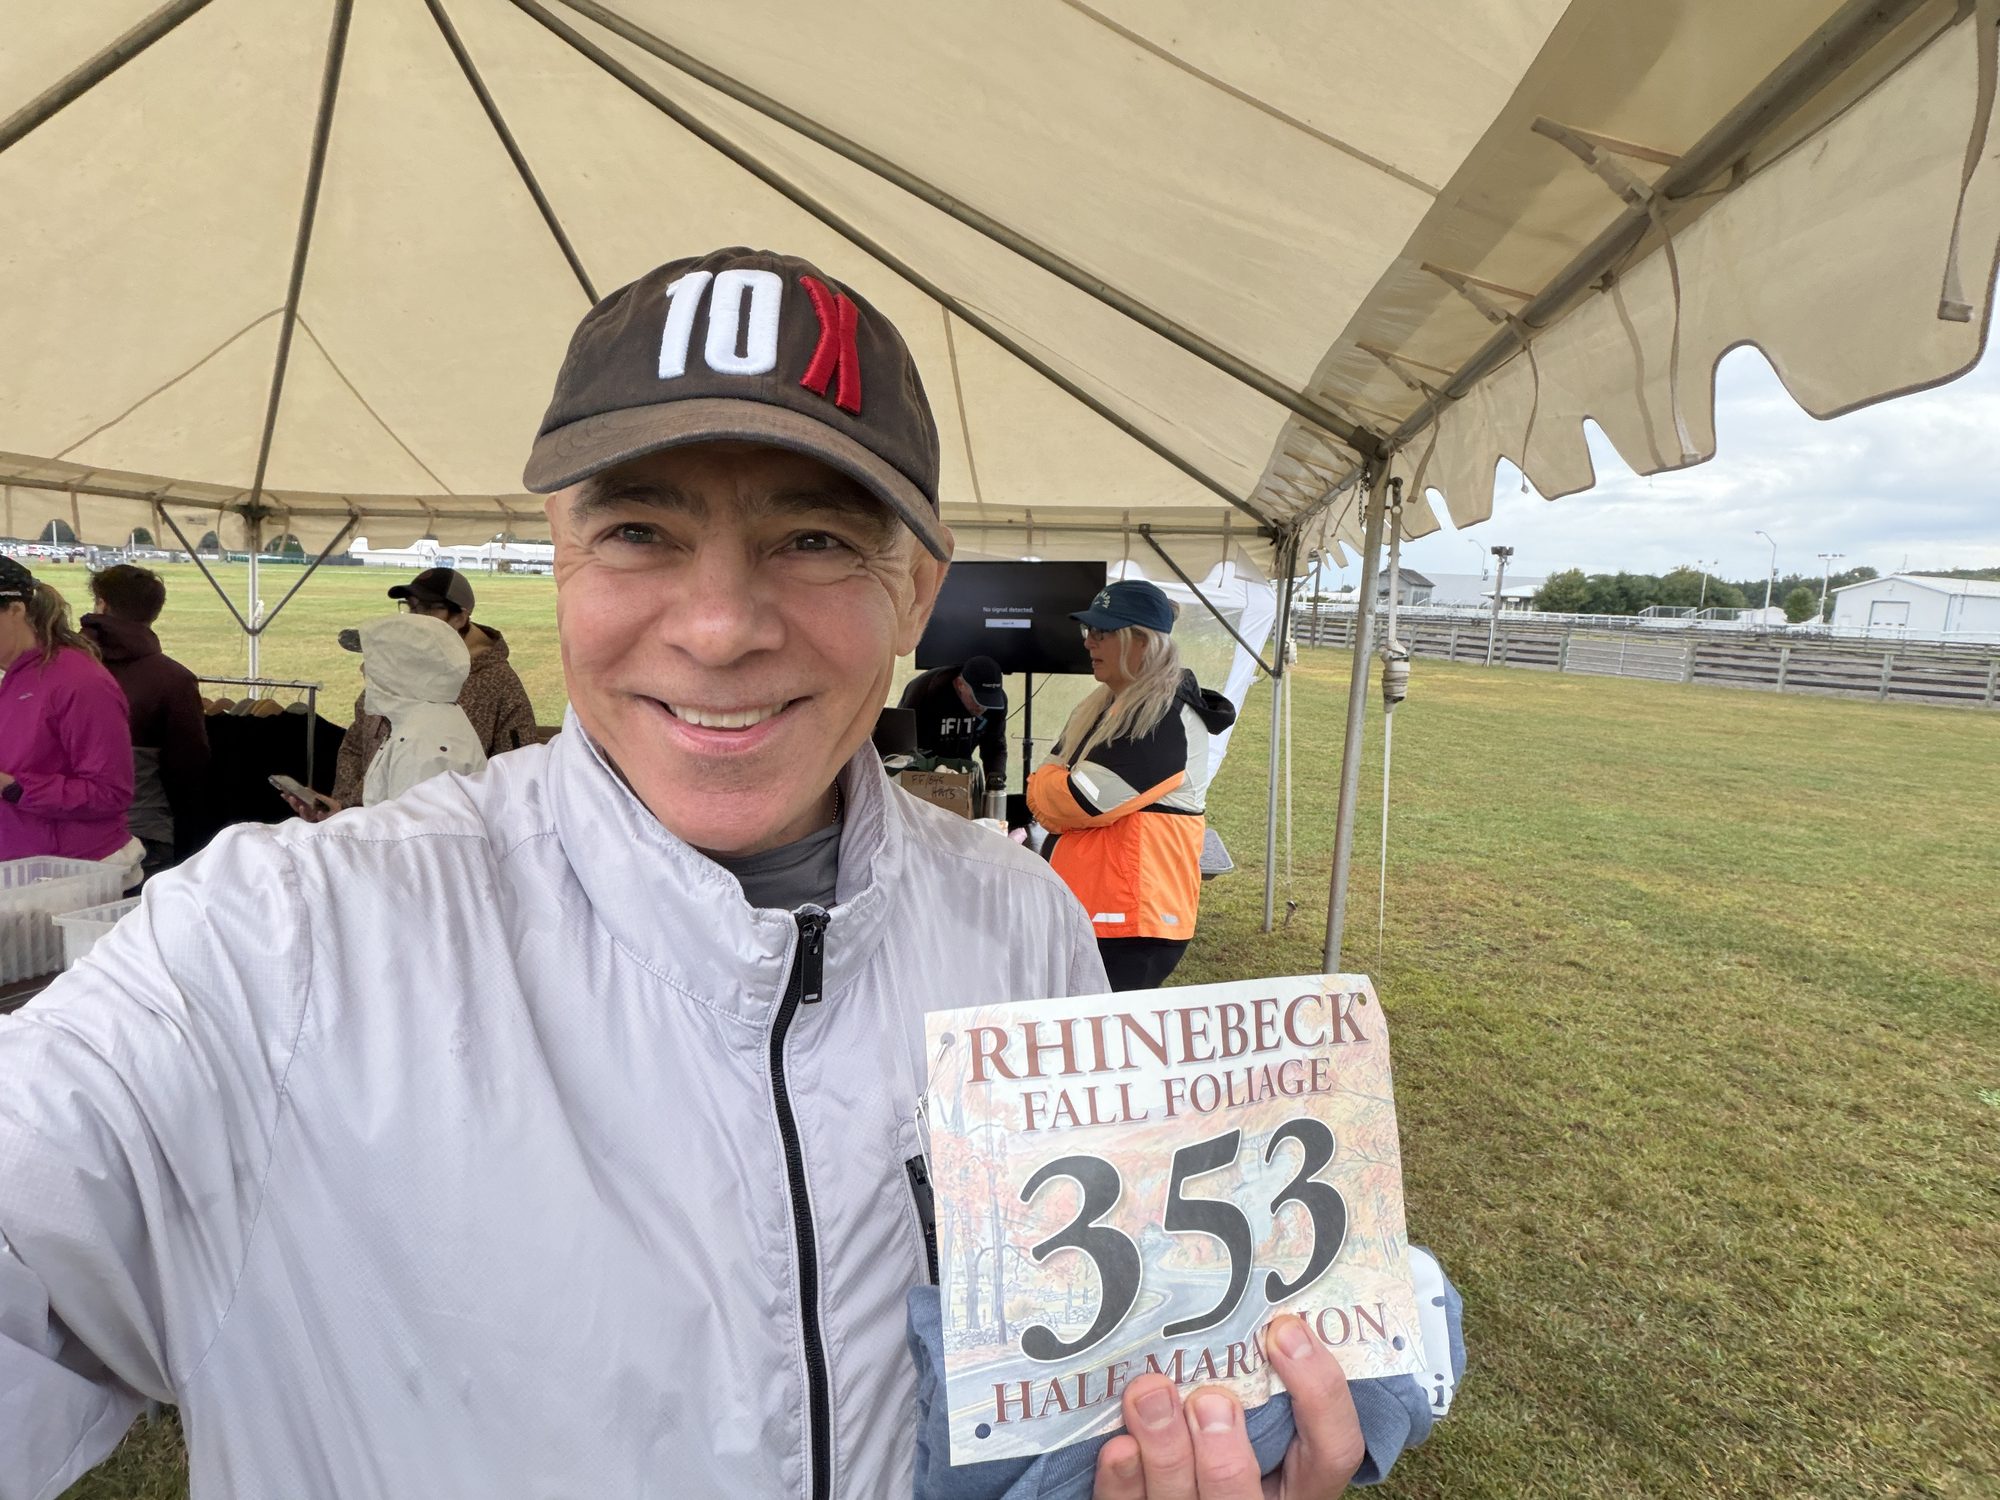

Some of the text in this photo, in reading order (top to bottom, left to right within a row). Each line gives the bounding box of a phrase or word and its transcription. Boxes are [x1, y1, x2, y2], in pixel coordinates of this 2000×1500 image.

[992, 606, 1008, 614] signal
[964, 992, 1369, 1084] RHINEBECK
[1021, 1057, 1333, 1131] FALL FOLIAGE
[1019, 1118, 1347, 1362] 353
[992, 1302, 1387, 1424] HALF MARAON
